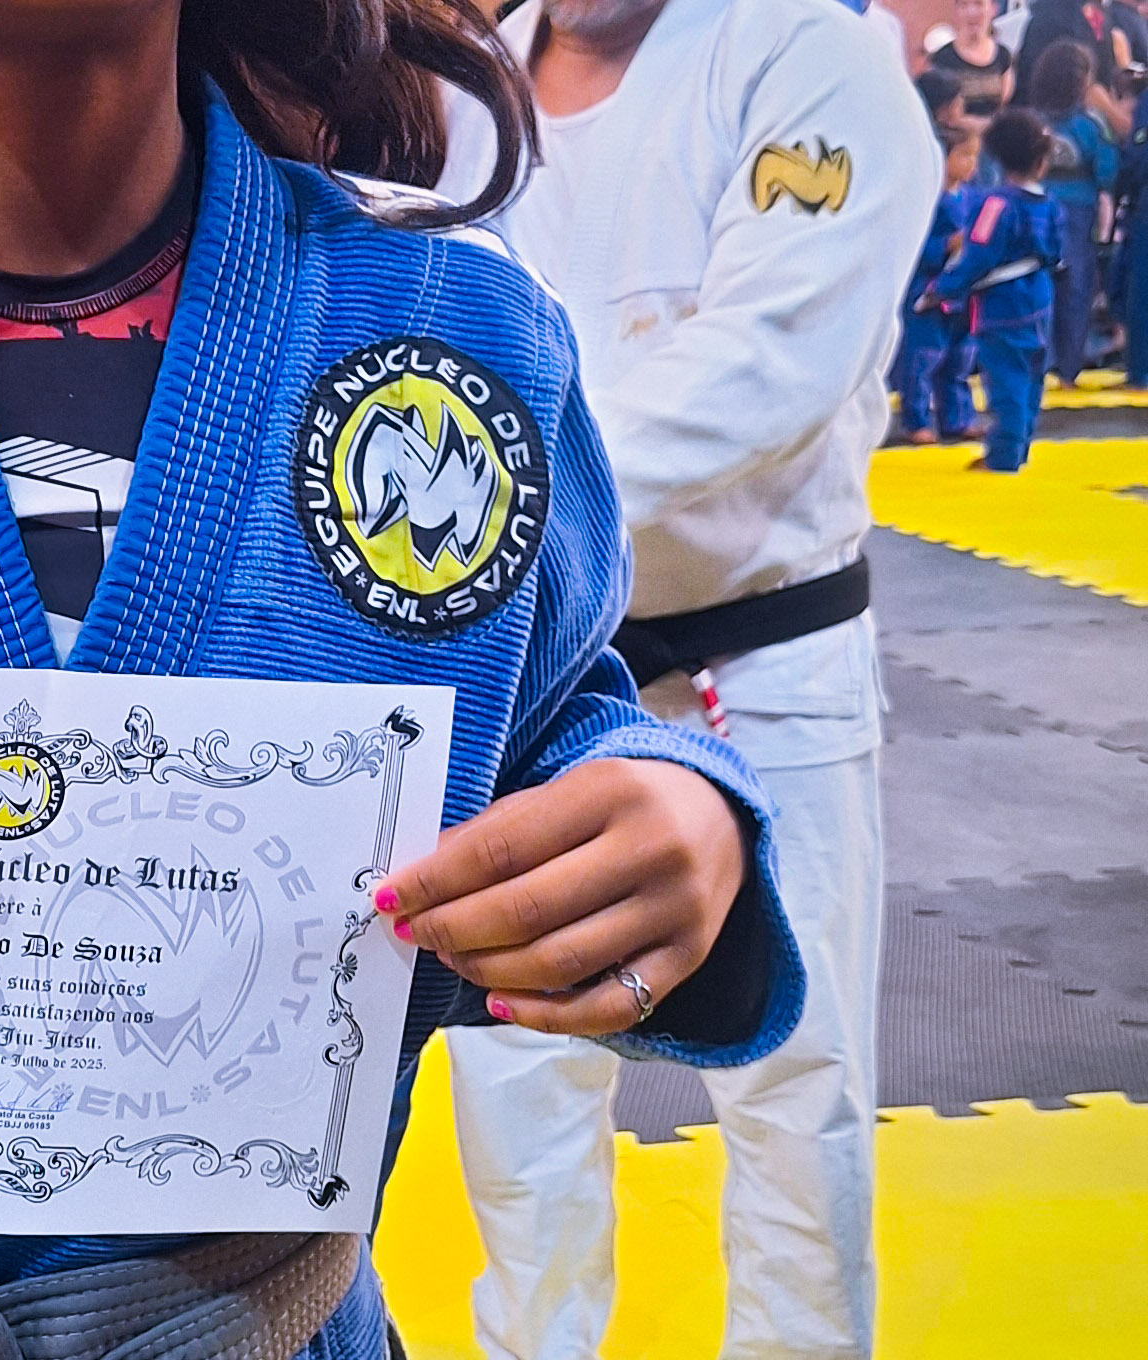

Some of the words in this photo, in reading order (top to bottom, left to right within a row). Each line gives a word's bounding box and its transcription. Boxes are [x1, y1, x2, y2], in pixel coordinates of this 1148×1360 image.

[491, 412, 532, 472] DE
[303, 405, 361, 577] EQUIPE
[445, 483, 540, 617] LUTAS
[367, 584, 427, 625] ENL
[39, 756, 58, 777] DE
[30, 779, 61, 830] LUTAS
[83, 857, 121, 888] de
[133, 855, 242, 893] Lutas
[254, 834, 316, 901] DE
[31, 897, 42, 916] à
[21, 932, 64, 960] De
[72, 936, 164, 968] Souza
[6, 975, 53, 992] suas
[58, 979, 148, 999] condições
[213, 917, 324, 1093] LUTAS
[0, 1003, 116, 1024] satisfazendo
[122, 1009, 155, 1024] aos
[10, 1054, 49, 1069] Julho
[53, 1057, 67, 1069] de
[70, 1058, 107, 1070] 2025.
[77, 1085, 188, 1120] ENL
